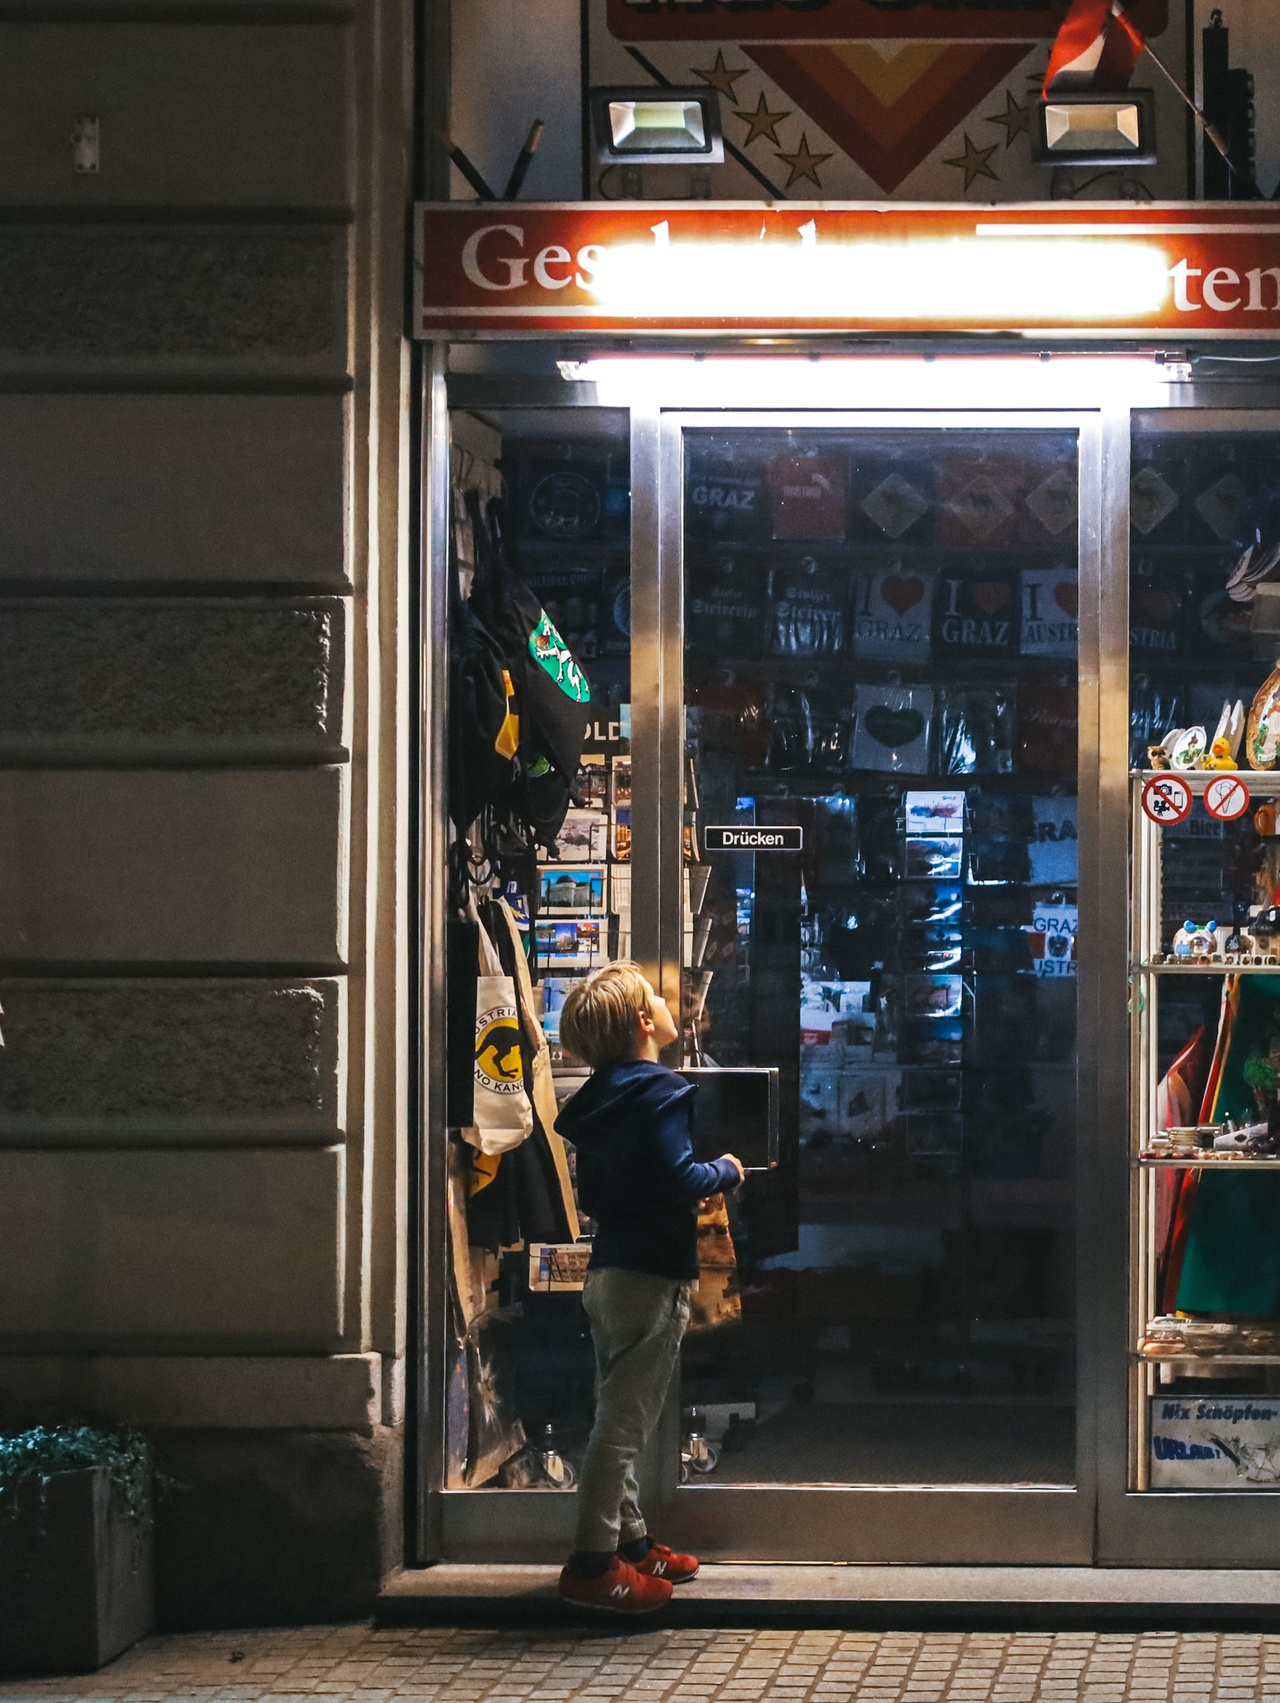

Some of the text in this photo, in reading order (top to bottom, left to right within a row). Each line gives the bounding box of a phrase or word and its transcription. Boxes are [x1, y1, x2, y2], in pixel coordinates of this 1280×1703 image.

[692, 485, 755, 510] GRAZ
[945, 579, 963, 617] I
[941, 619, 1009, 645] GRAZ
[722, 831, 785, 847] Drücken
